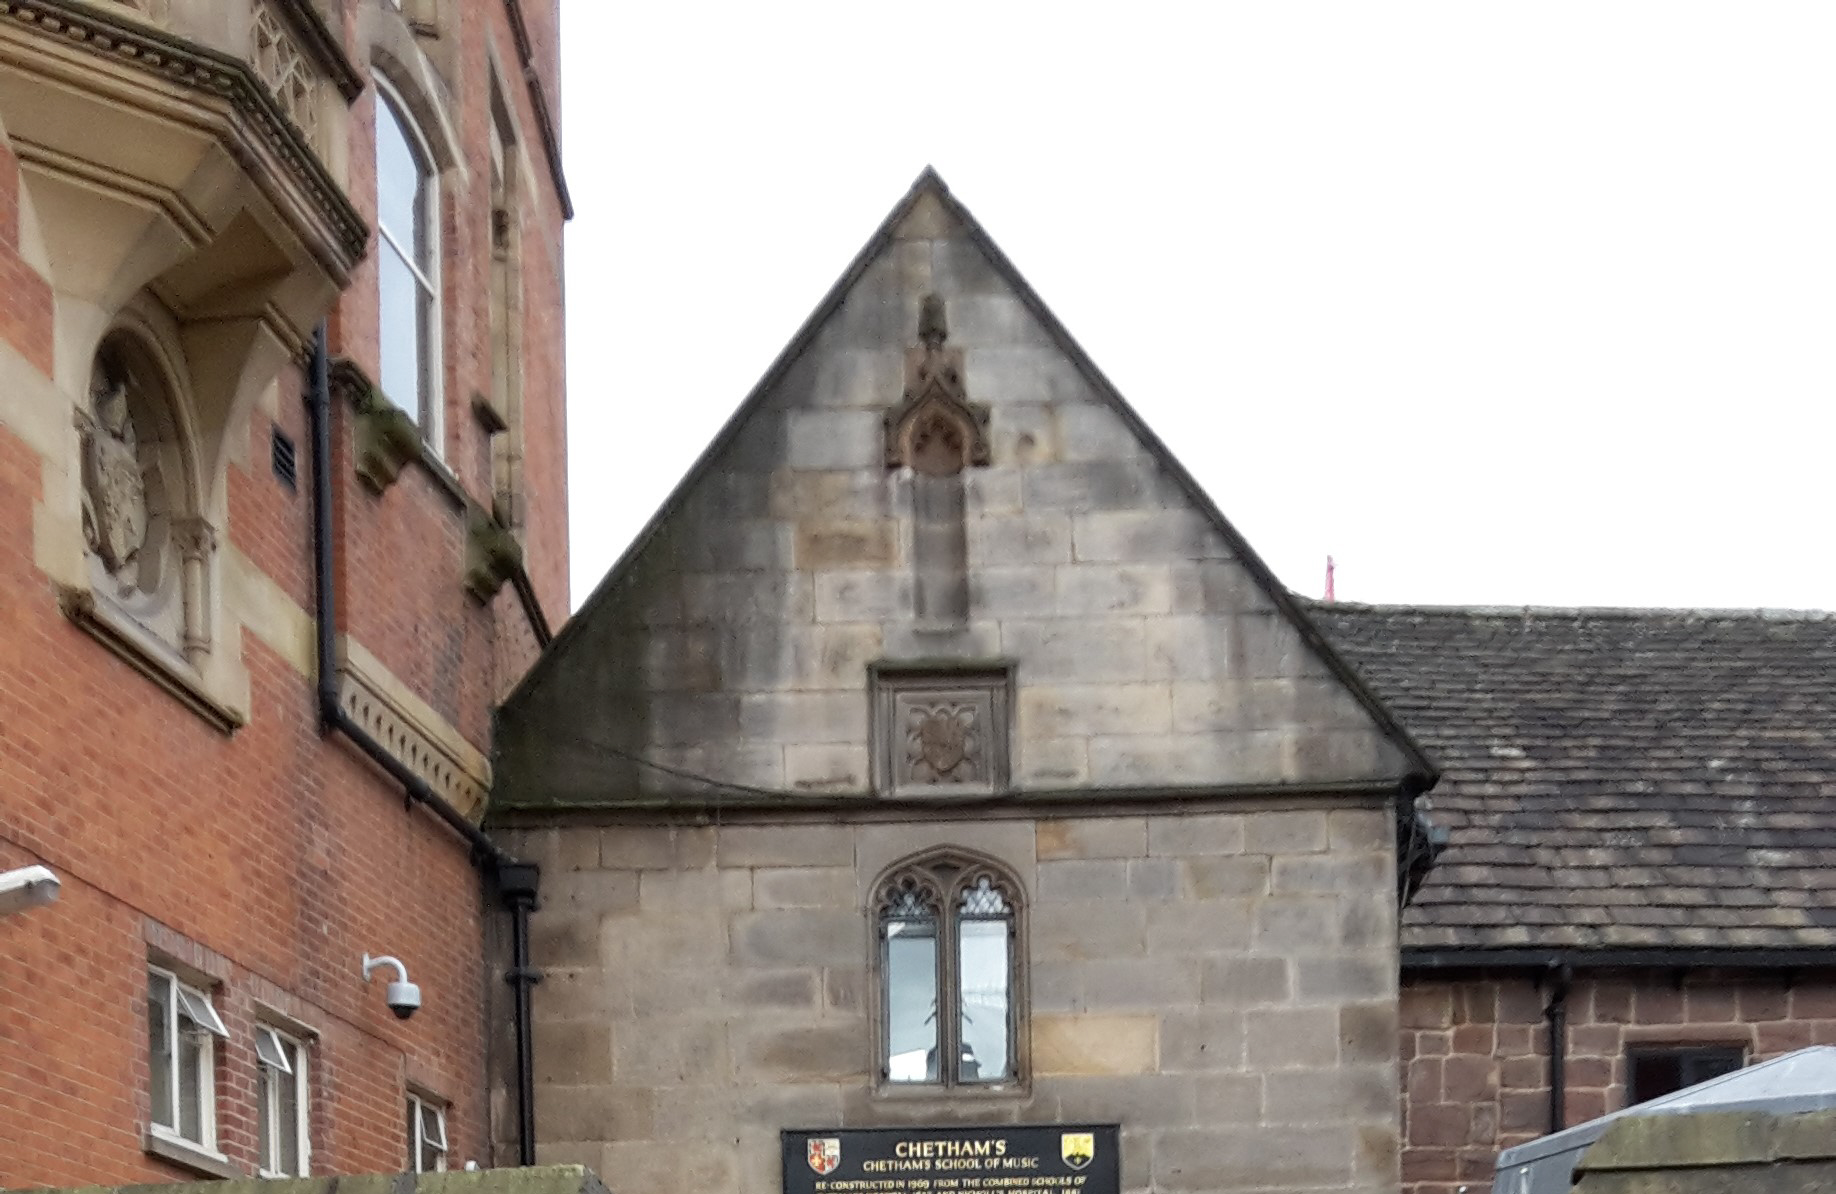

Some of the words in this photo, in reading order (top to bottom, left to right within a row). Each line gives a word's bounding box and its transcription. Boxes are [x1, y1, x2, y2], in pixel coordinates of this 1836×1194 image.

[895, 1139, 1007, 1158] CHETHAM'S
[934, 1157, 982, 1171] SCHOOL
[984, 1158, 999, 1170] OF
[1002, 1156, 1040, 1169] MUSIC
[895, 1179, 906, 1189] IN
[907, 1179, 930, 1189] 1969
[933, 1178, 959, 1189] FROM
[961, 1178, 981, 1188] THE
[982, 1177, 1030, 1187] COMBINED
[1031, 1176, 1073, 1186] SCHOOLS
[1073, 1175, 1088, 1185] OF
